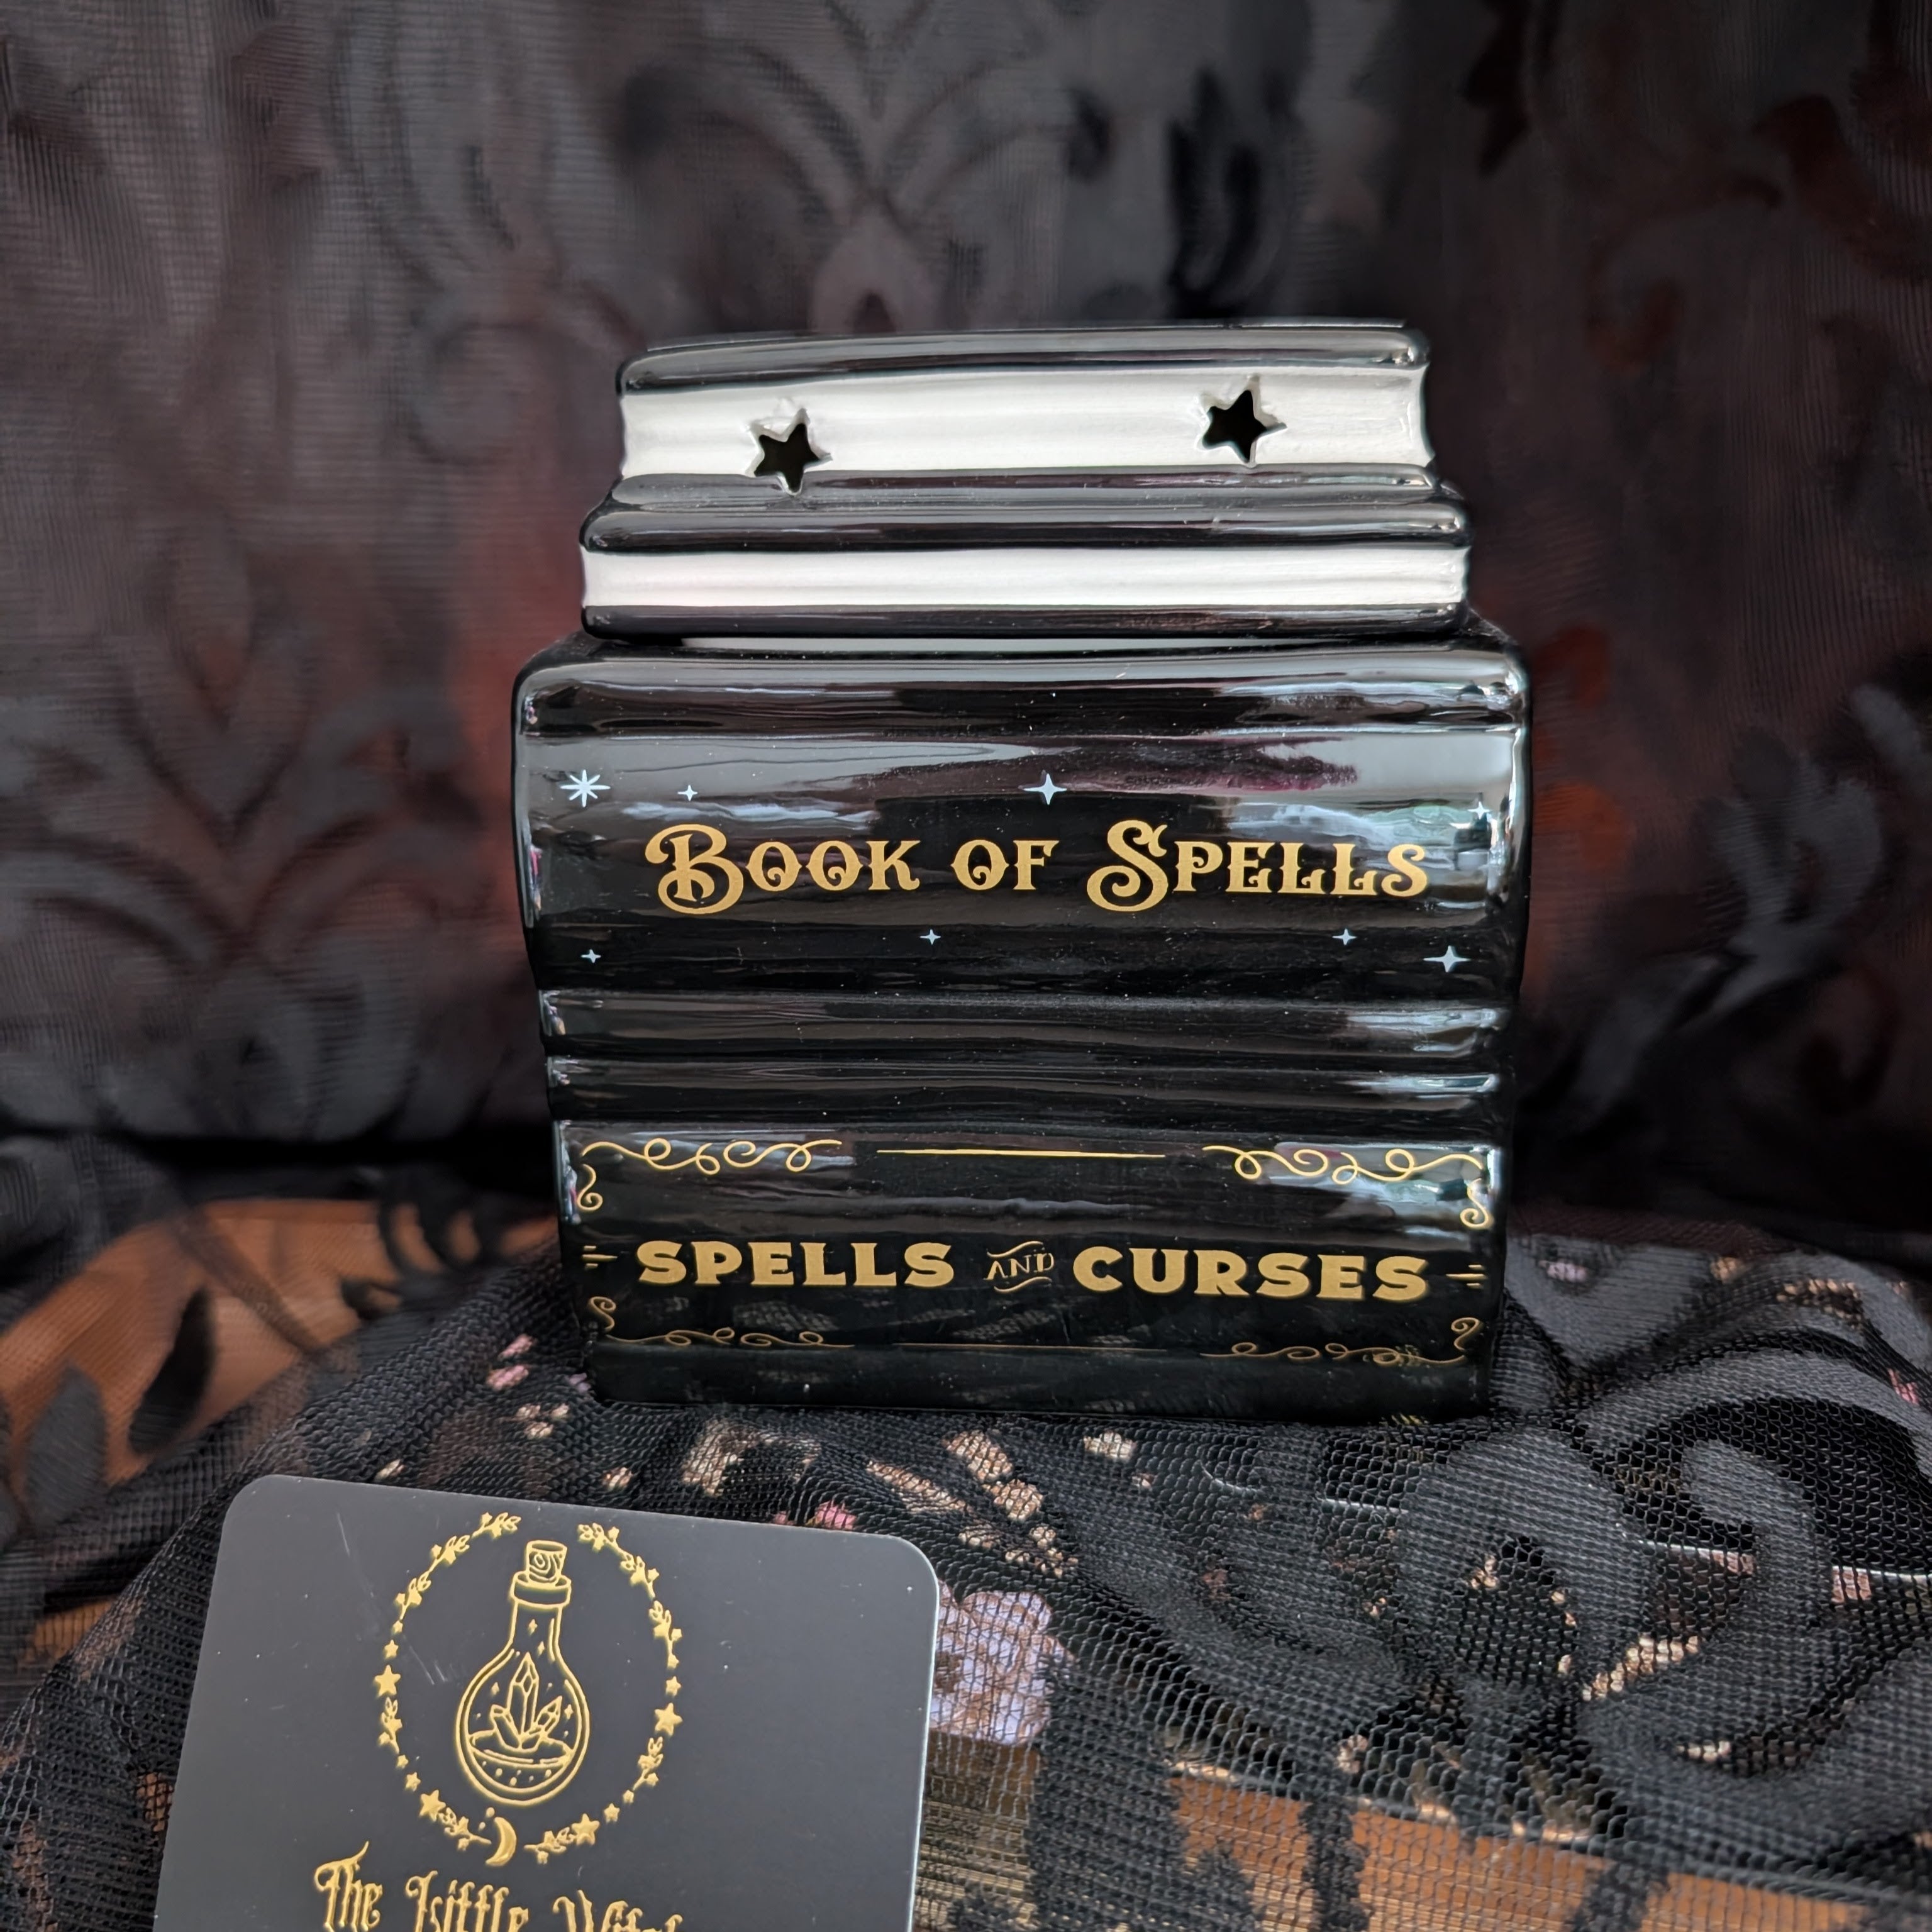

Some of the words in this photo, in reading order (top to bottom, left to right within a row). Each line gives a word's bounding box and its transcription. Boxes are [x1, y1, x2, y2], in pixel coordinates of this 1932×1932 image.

[636, 1240, 955, 1288] SPELLS
[983, 1252, 1055, 1280] AND
[1072, 1246, 1430, 1302] CURSES
[314, 1840, 383, 1932] The
